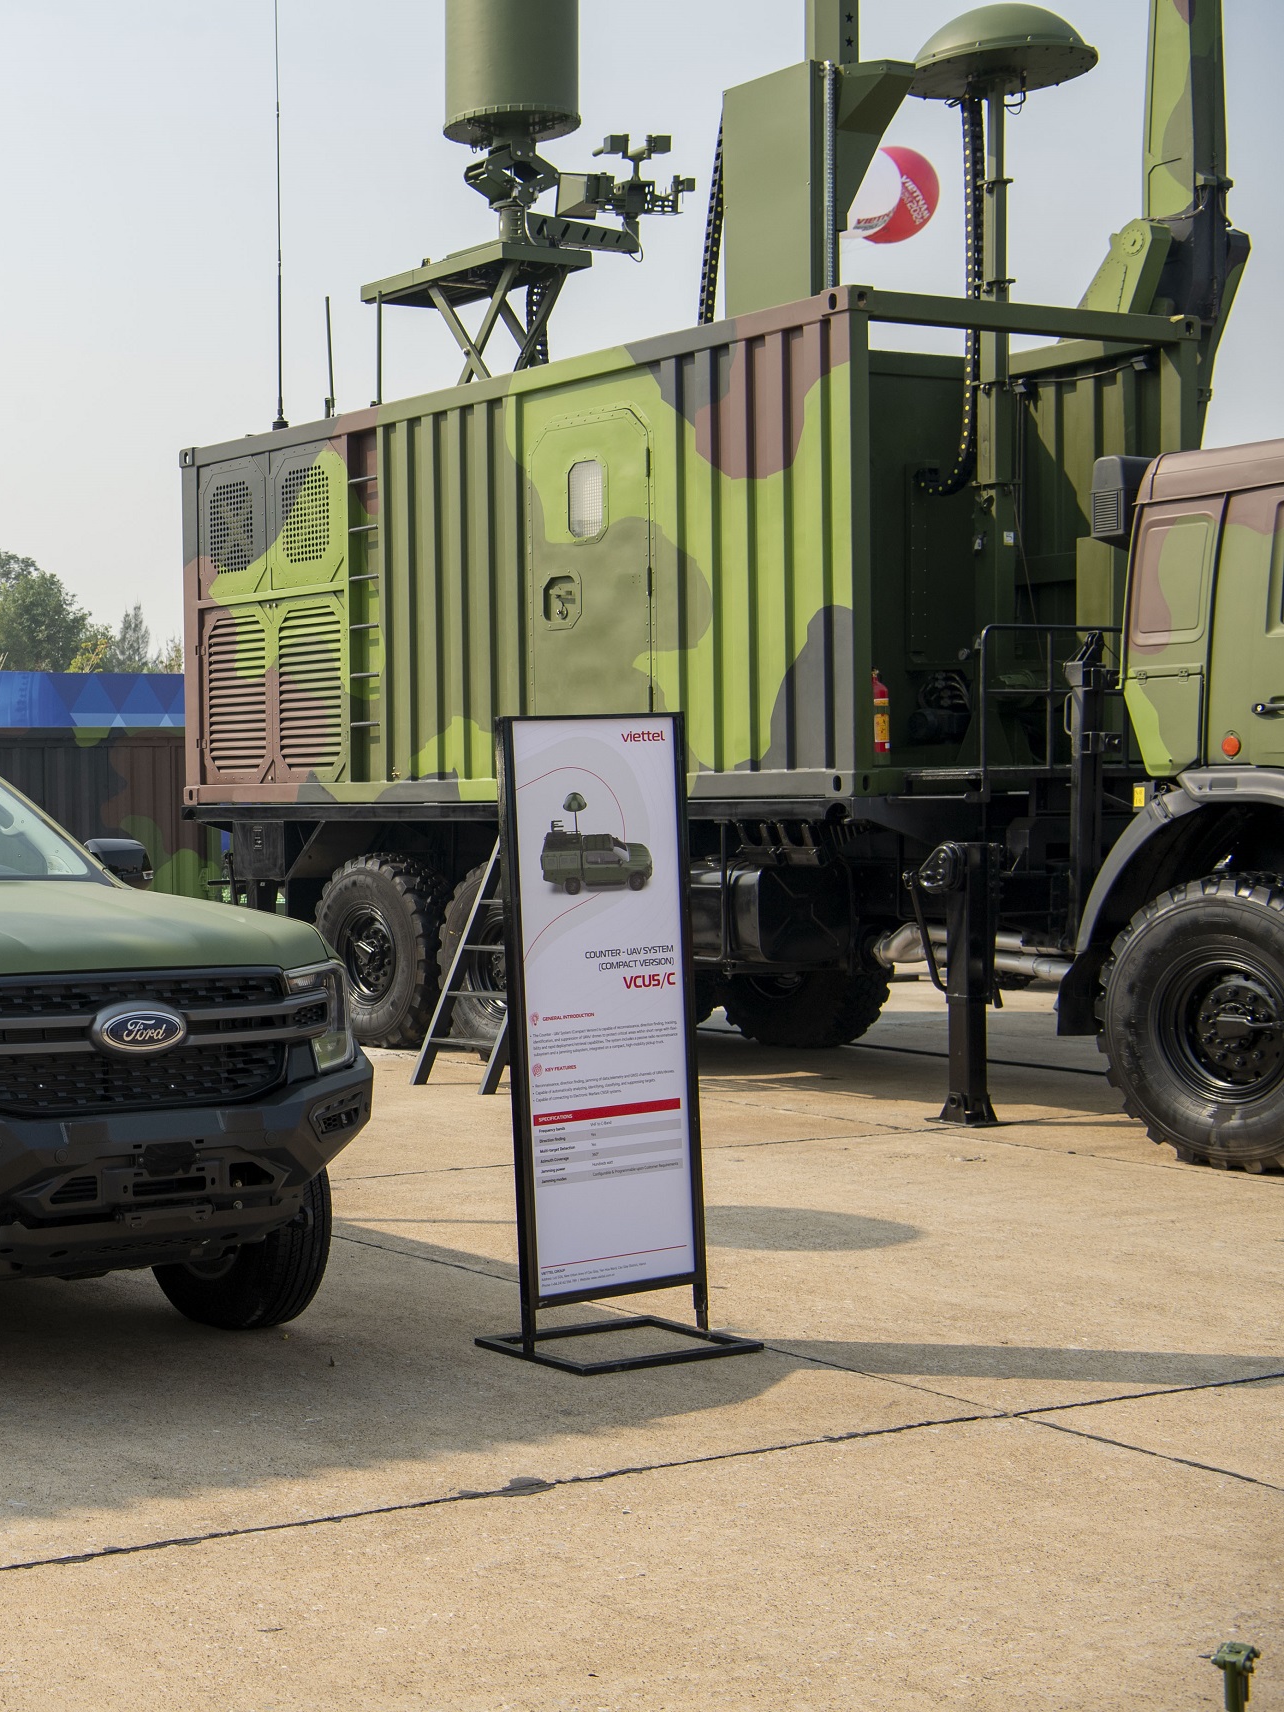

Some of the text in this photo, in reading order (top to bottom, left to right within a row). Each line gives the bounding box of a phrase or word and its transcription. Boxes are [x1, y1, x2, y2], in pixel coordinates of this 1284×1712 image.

[901, 174, 930, 220] VIETNAM
[621, 730, 666, 742] viettel
[585, 949, 621, 959] COUNTER
[627, 947, 642, 956] UAV
[643, 945, 674, 955] SYSTEM
[599, 957, 675, 972] (COMPACT VERSION)
[623, 972, 676, 989] VCU5/C
[563, 1012, 595, 1020] INTRODUCTION
[123, 1019, 166, 1041] Ford
[539, 1114, 573, 1122] SPECIFICATIONS
